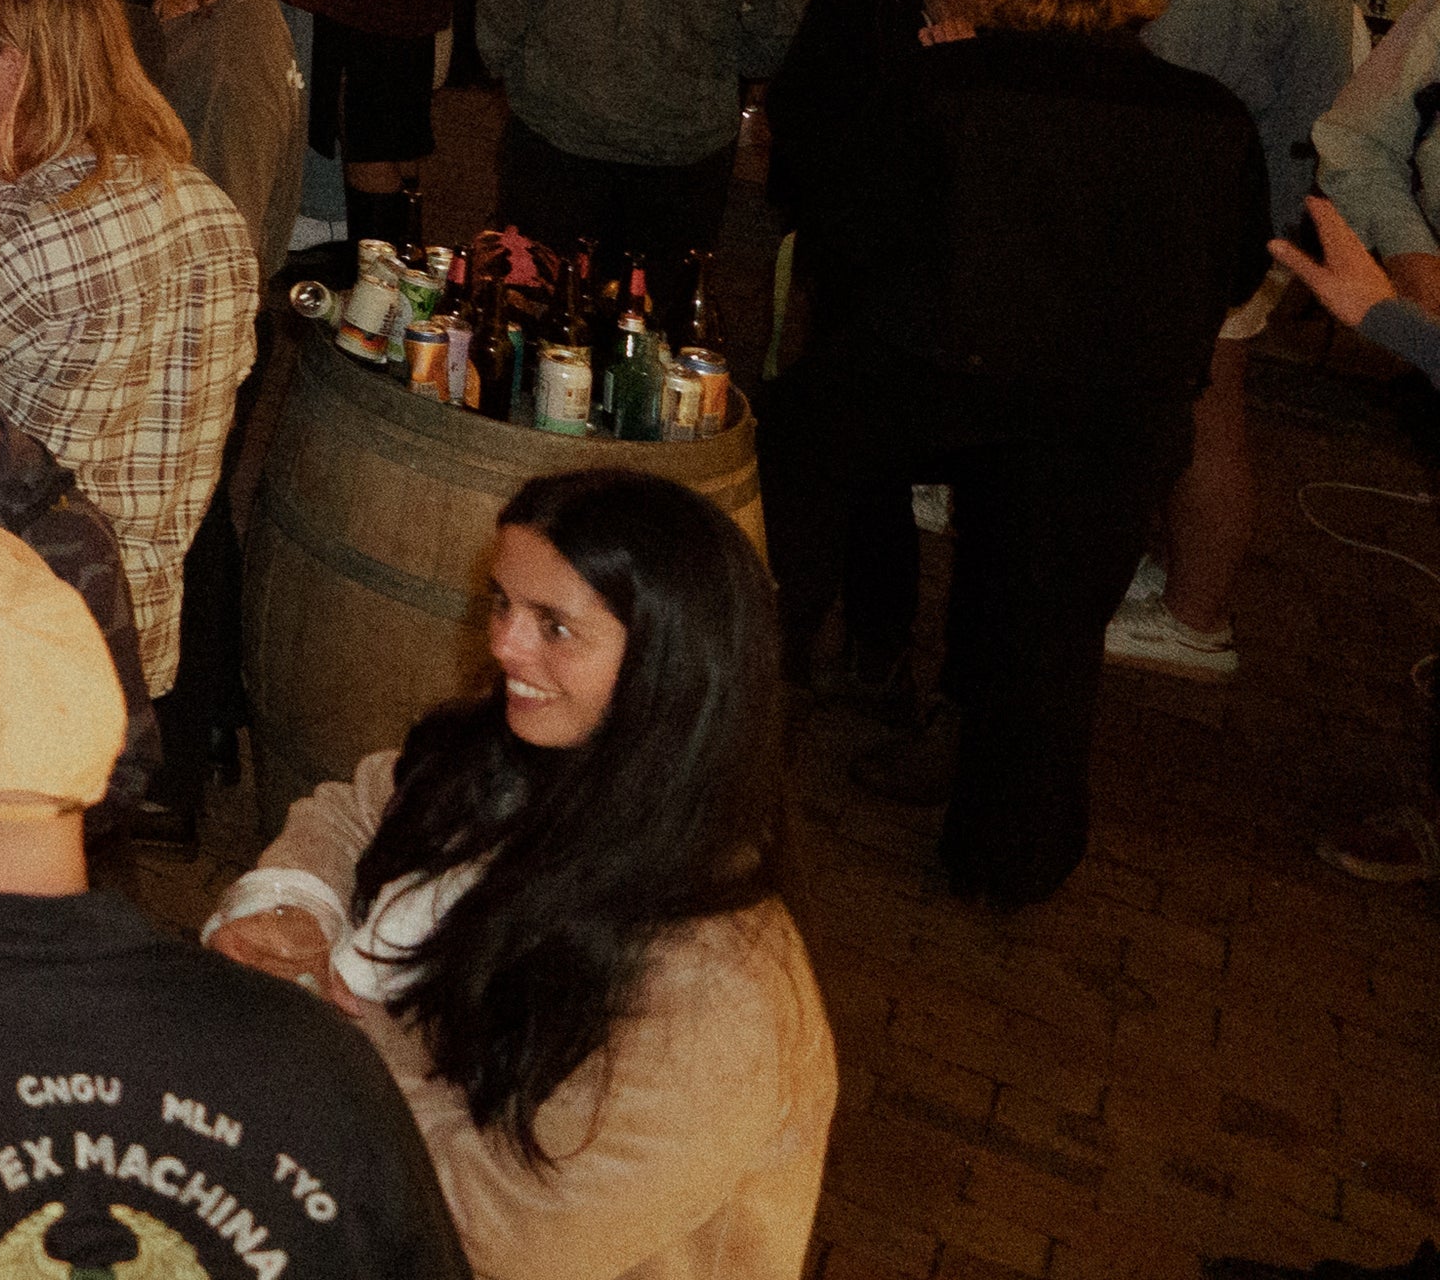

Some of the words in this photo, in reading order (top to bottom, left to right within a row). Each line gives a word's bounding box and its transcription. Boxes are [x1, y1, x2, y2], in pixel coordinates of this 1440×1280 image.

[74, 1131, 289, 1280] MACHINA
[161, 1092, 243, 1146] MLN
[273, 1153, 338, 1223] TYO
